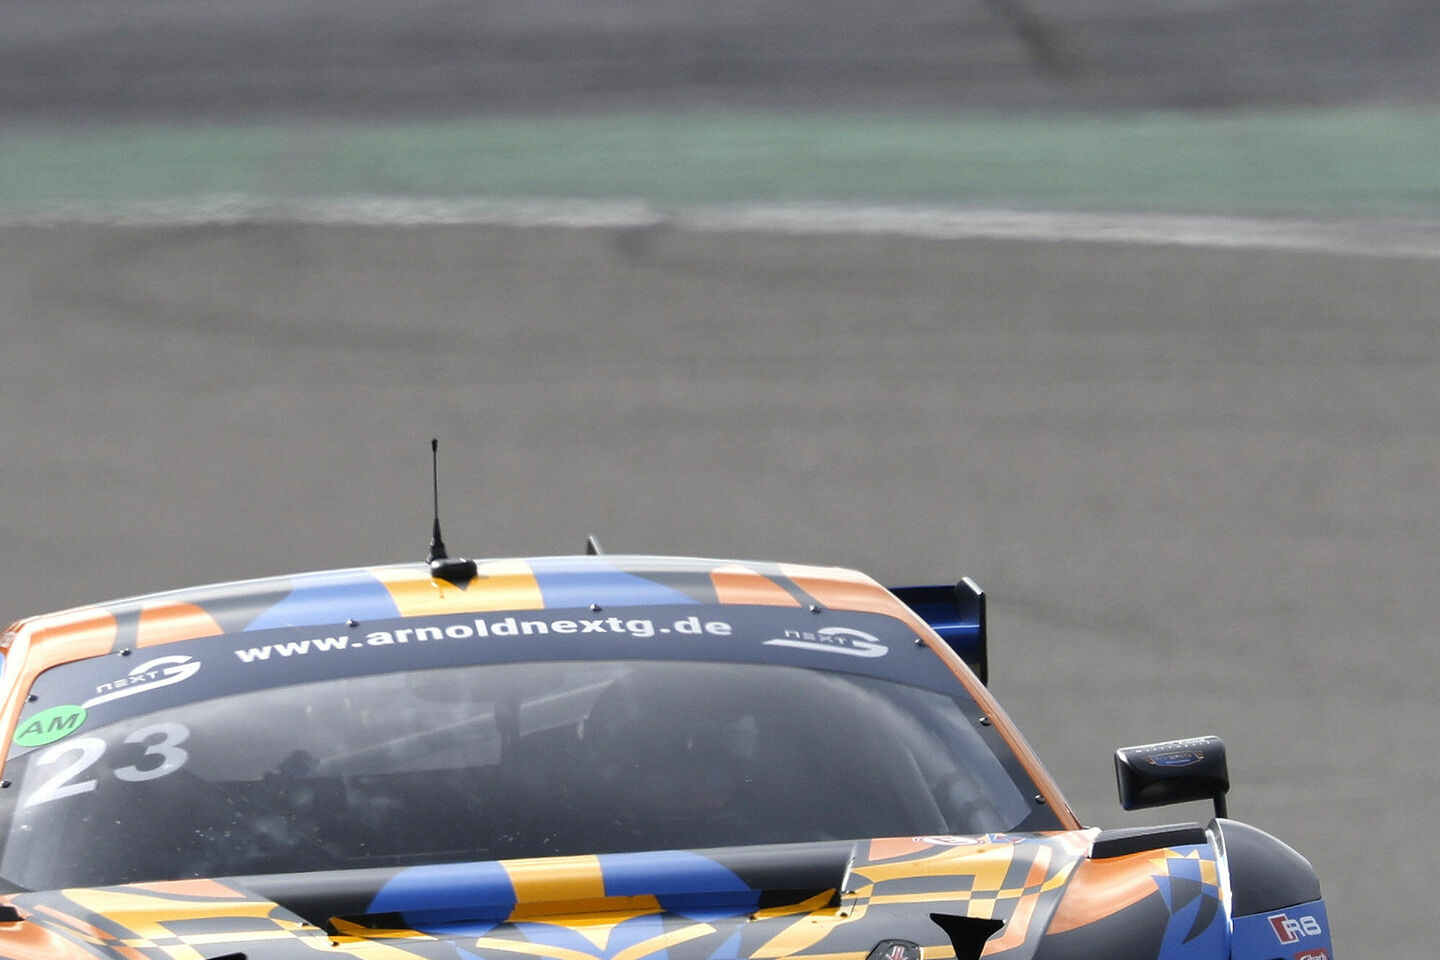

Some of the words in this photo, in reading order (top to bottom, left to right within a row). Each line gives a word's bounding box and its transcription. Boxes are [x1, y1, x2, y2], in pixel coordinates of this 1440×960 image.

[234, 616, 732, 663] www.arnoldnextg.de
[20, 711, 82, 735] AM
[22, 721, 191, 808] 23
